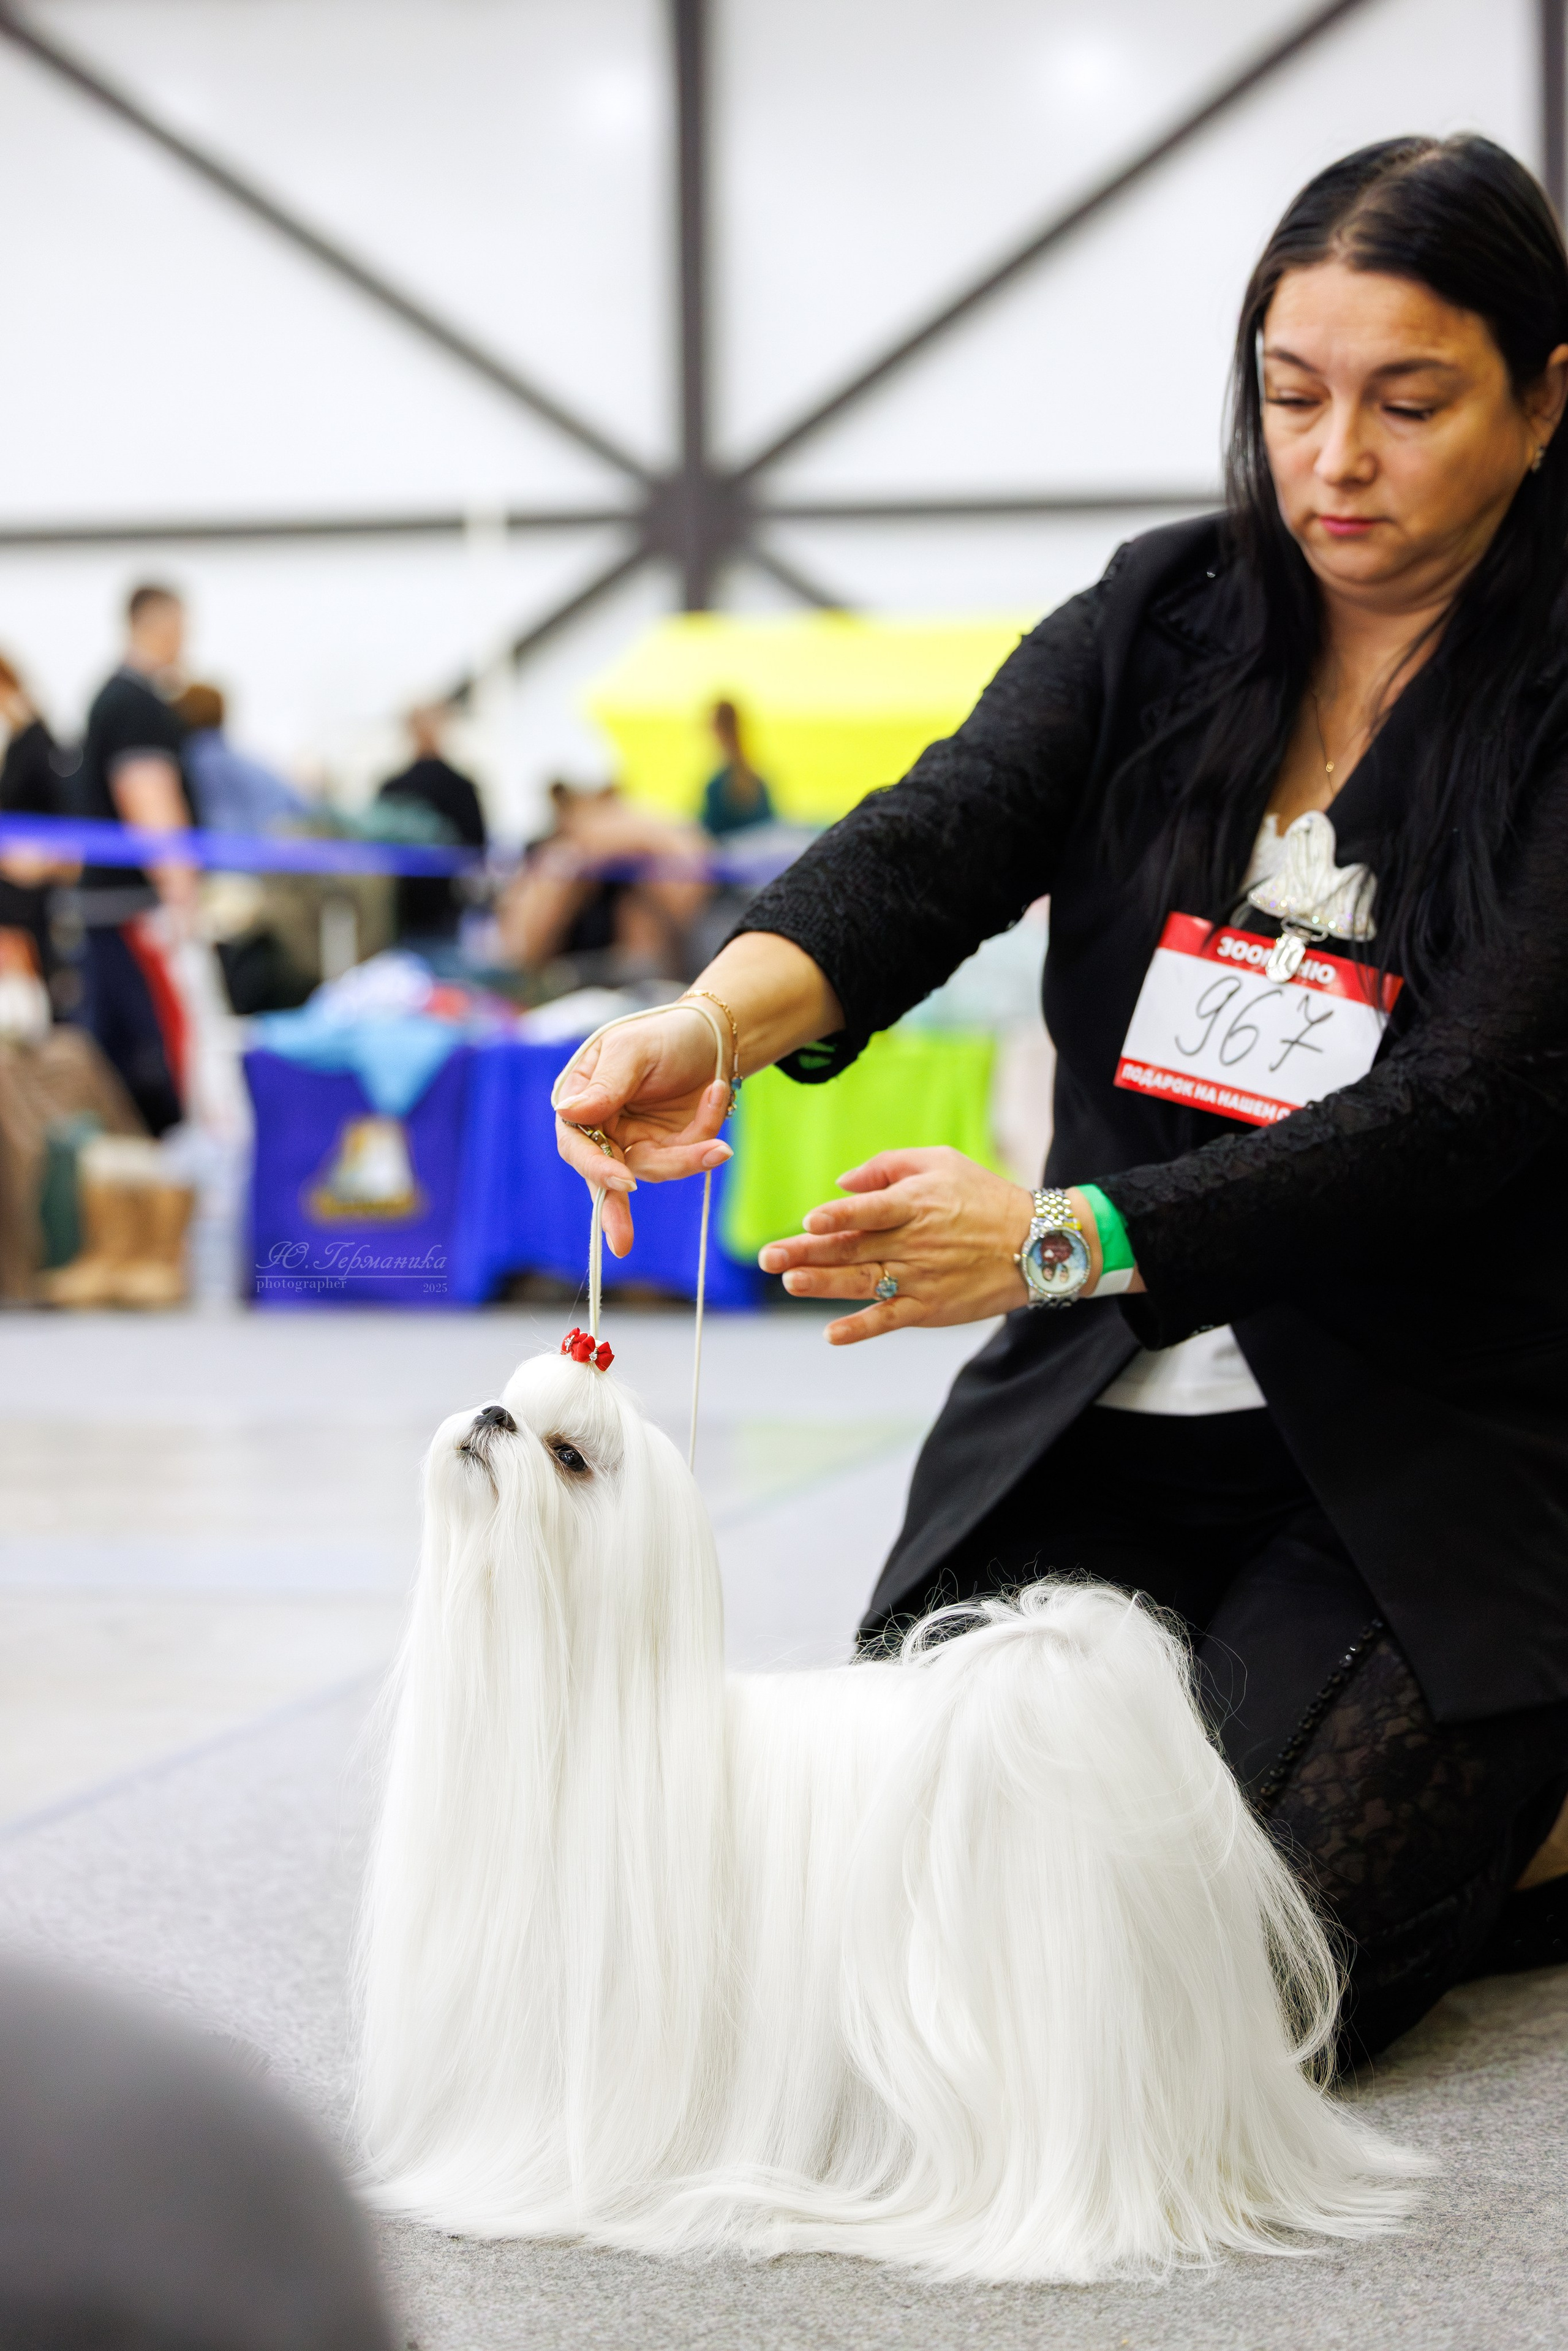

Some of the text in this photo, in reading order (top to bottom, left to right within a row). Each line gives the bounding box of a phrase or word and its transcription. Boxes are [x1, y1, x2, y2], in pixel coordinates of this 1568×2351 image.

[1216, 936, 1337, 985] ЗООНЮ
[1174, 975, 1334, 1072] 967
[1121, 1063, 1194, 1097] ПОДАРОК
[1194, 1082, 1218, 1104] НА
[1217, 1090, 1277, 1121] НАШЕМ
